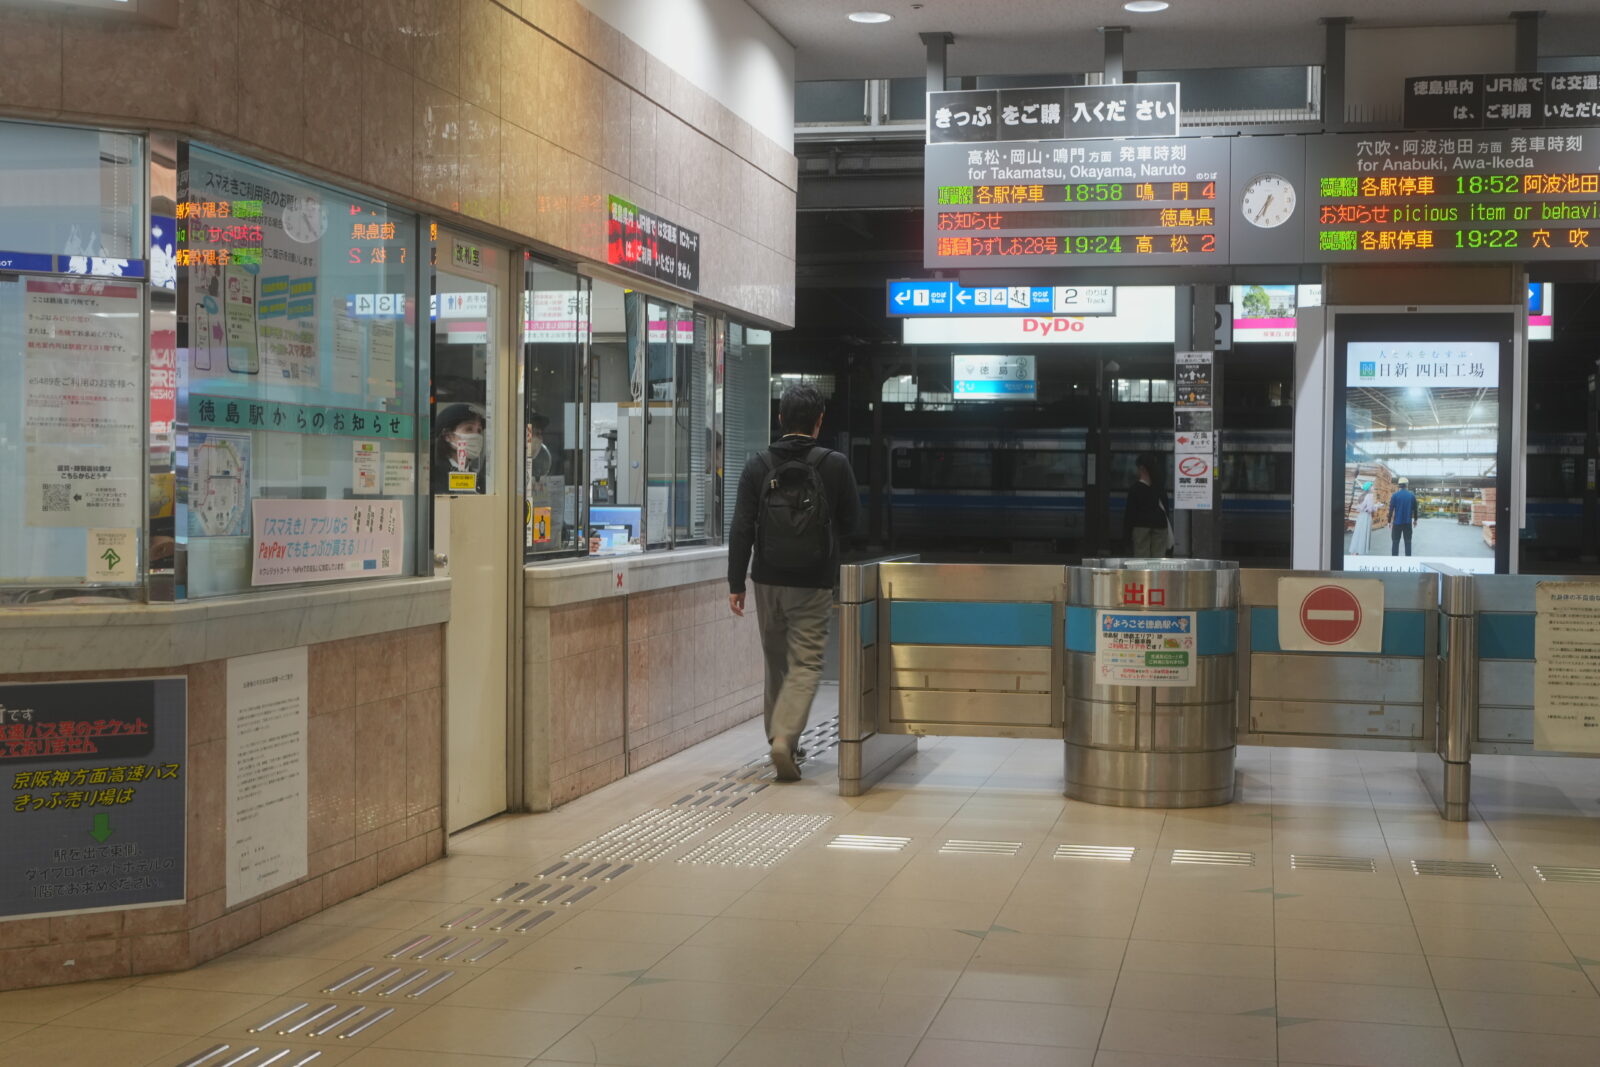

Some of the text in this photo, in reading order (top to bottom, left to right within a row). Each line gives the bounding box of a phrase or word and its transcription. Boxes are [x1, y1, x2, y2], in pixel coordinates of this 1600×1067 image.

[1413, 74, 1600, 96] 徳島県内JR線では交通
[968, 145, 1187, 166] 高松・岡山・鳴門 方面 発車時刻
[1356, 135, 1583, 157] 穴吹・阿波池田 方面 発車時刻
[968, 164, 1186, 181] for Takamatsu, Okayama, Naruto
[1358, 156, 1534, 172] for Anabuki, Awa-Ikeda
[976, 185, 1045, 204] 各駅停車
[1064, 184, 1123, 201] 18:58
[1202, 182, 1216, 199] 4
[1361, 176, 1435, 197] 各駅停車
[1456, 175, 1519, 194] 18:52
[1524, 174, 1598, 194] 阿波池田
[938, 208, 1213, 230] お知らせ 徳島県
[1320, 202, 1600, 224] お知らせ picious item or behavi
[1064, 236, 1122, 254] 19:24
[1201, 234, 1216, 252] 2
[1360, 229, 1434, 250] 各駅停車
[1455, 229, 1519, 249] 19:22
[978, 291, 987, 303] 3
[994, 291, 1004, 303] 4
[1064, 288, 1078, 304] 2
[1023, 318, 1085, 337] DyDo
[1379, 362, 1409, 379] 日新
[198, 399, 401, 434] 徳島駅からのお知らせ
[1123, 582, 1165, 606] 出口
[1113, 618, 1179, 630] ようこそ徳島駅へ
[12, 762, 181, 790] 京阪神方面高速バス
[12, 788, 136, 812] きっぷ売り場は
